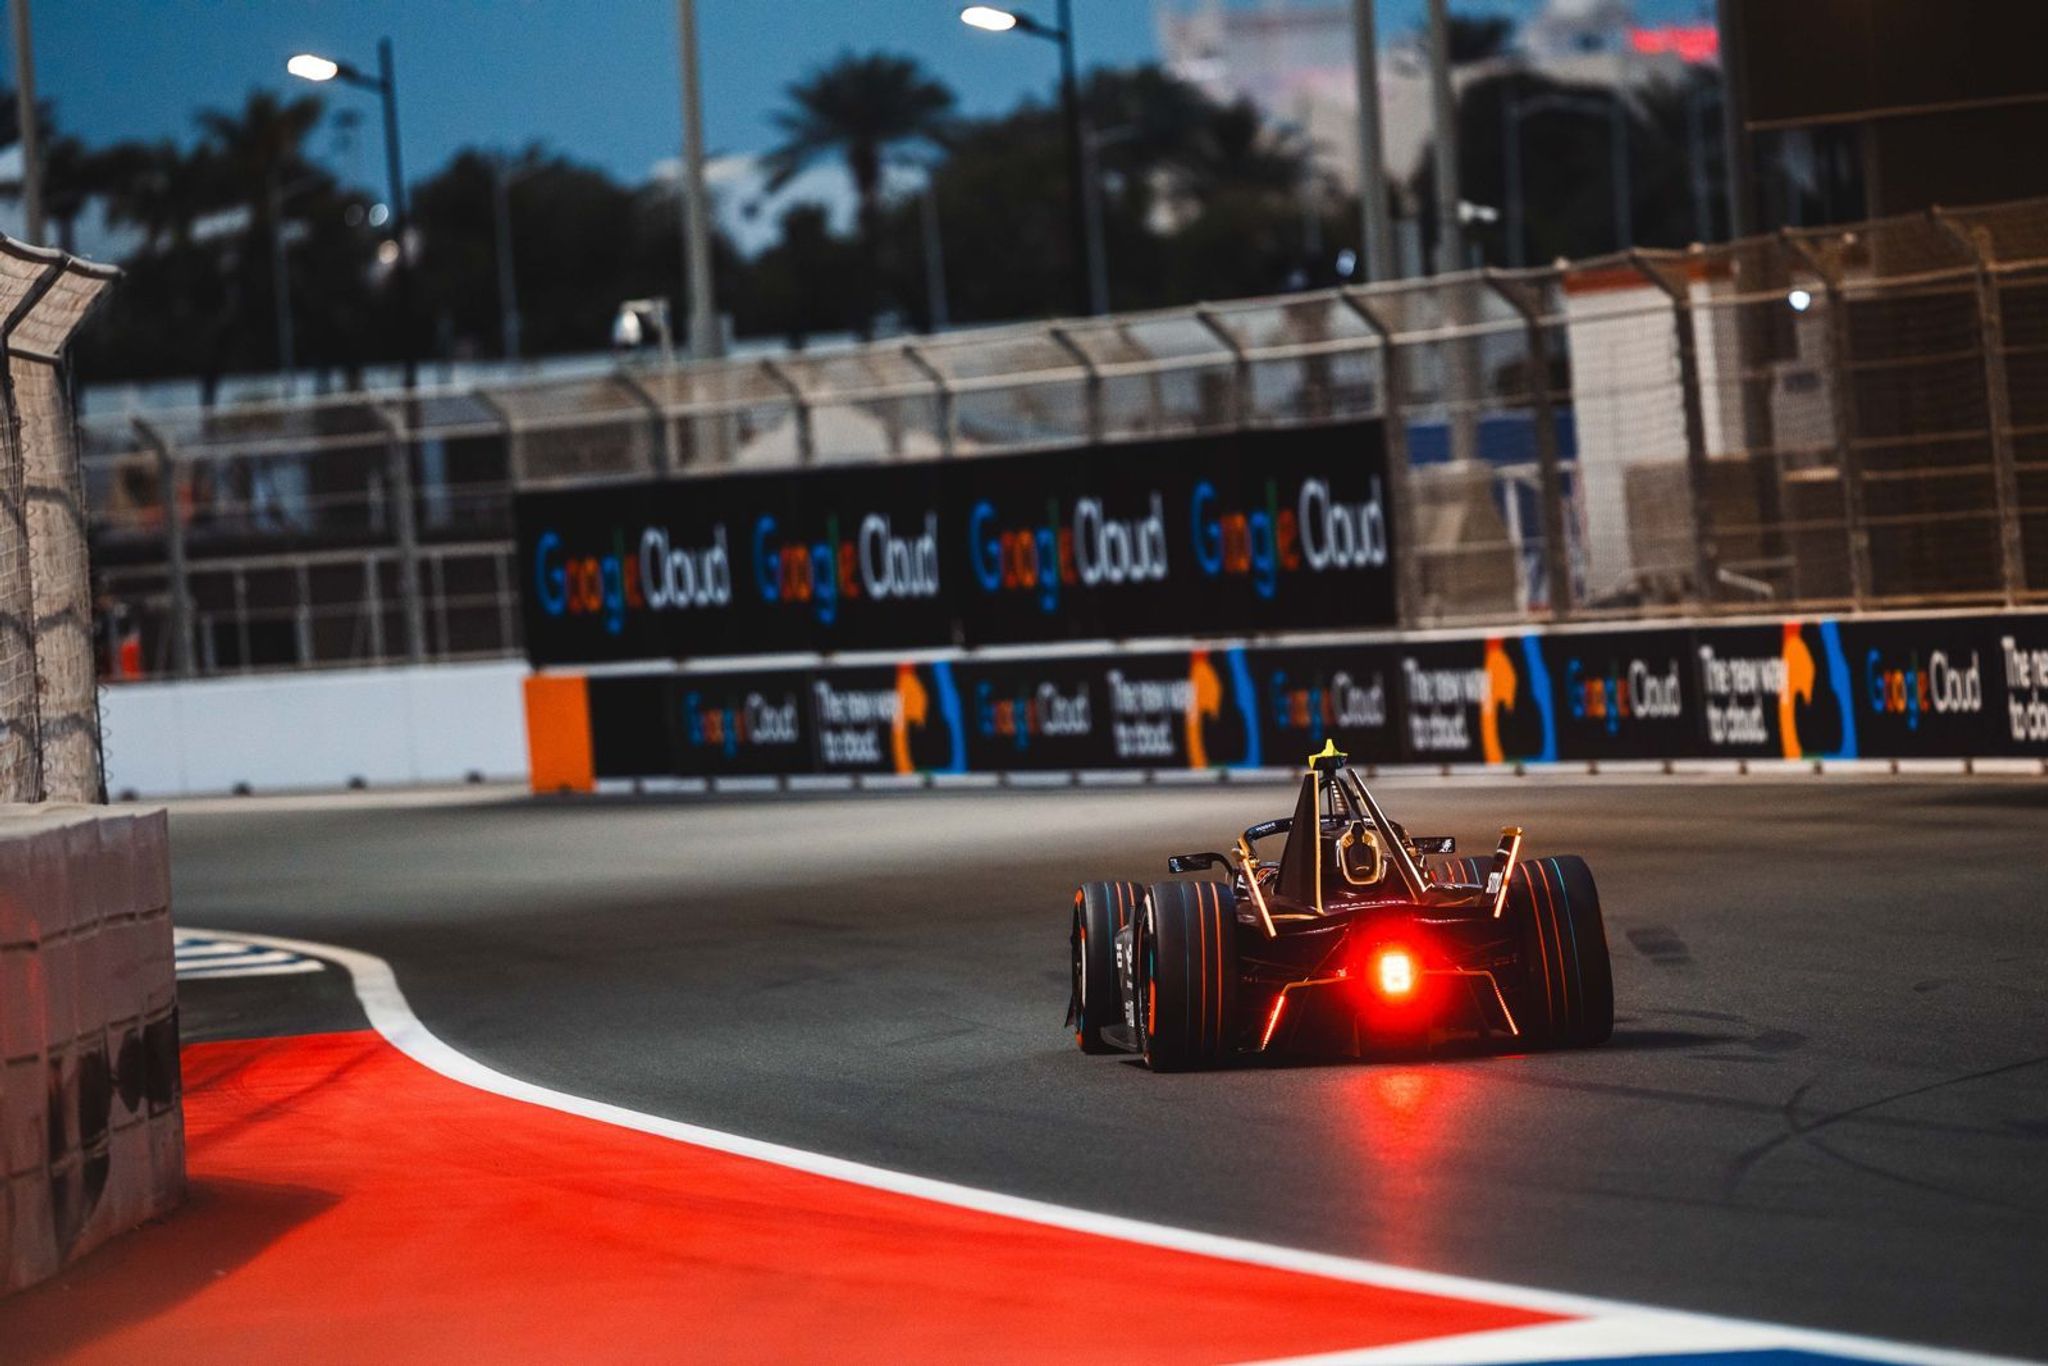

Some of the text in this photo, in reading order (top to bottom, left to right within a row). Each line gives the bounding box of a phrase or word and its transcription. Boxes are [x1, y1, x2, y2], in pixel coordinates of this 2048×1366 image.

[536, 523, 730, 635] Google Cloud
[752, 511, 939, 625] Google Cloud
[969, 492, 1168, 612] Google Cloud
[1190, 474, 1387, 598] Google Cloud
[1628, 658, 1682, 719] Cloud
[1866, 648, 1982, 730] Google Cloud
